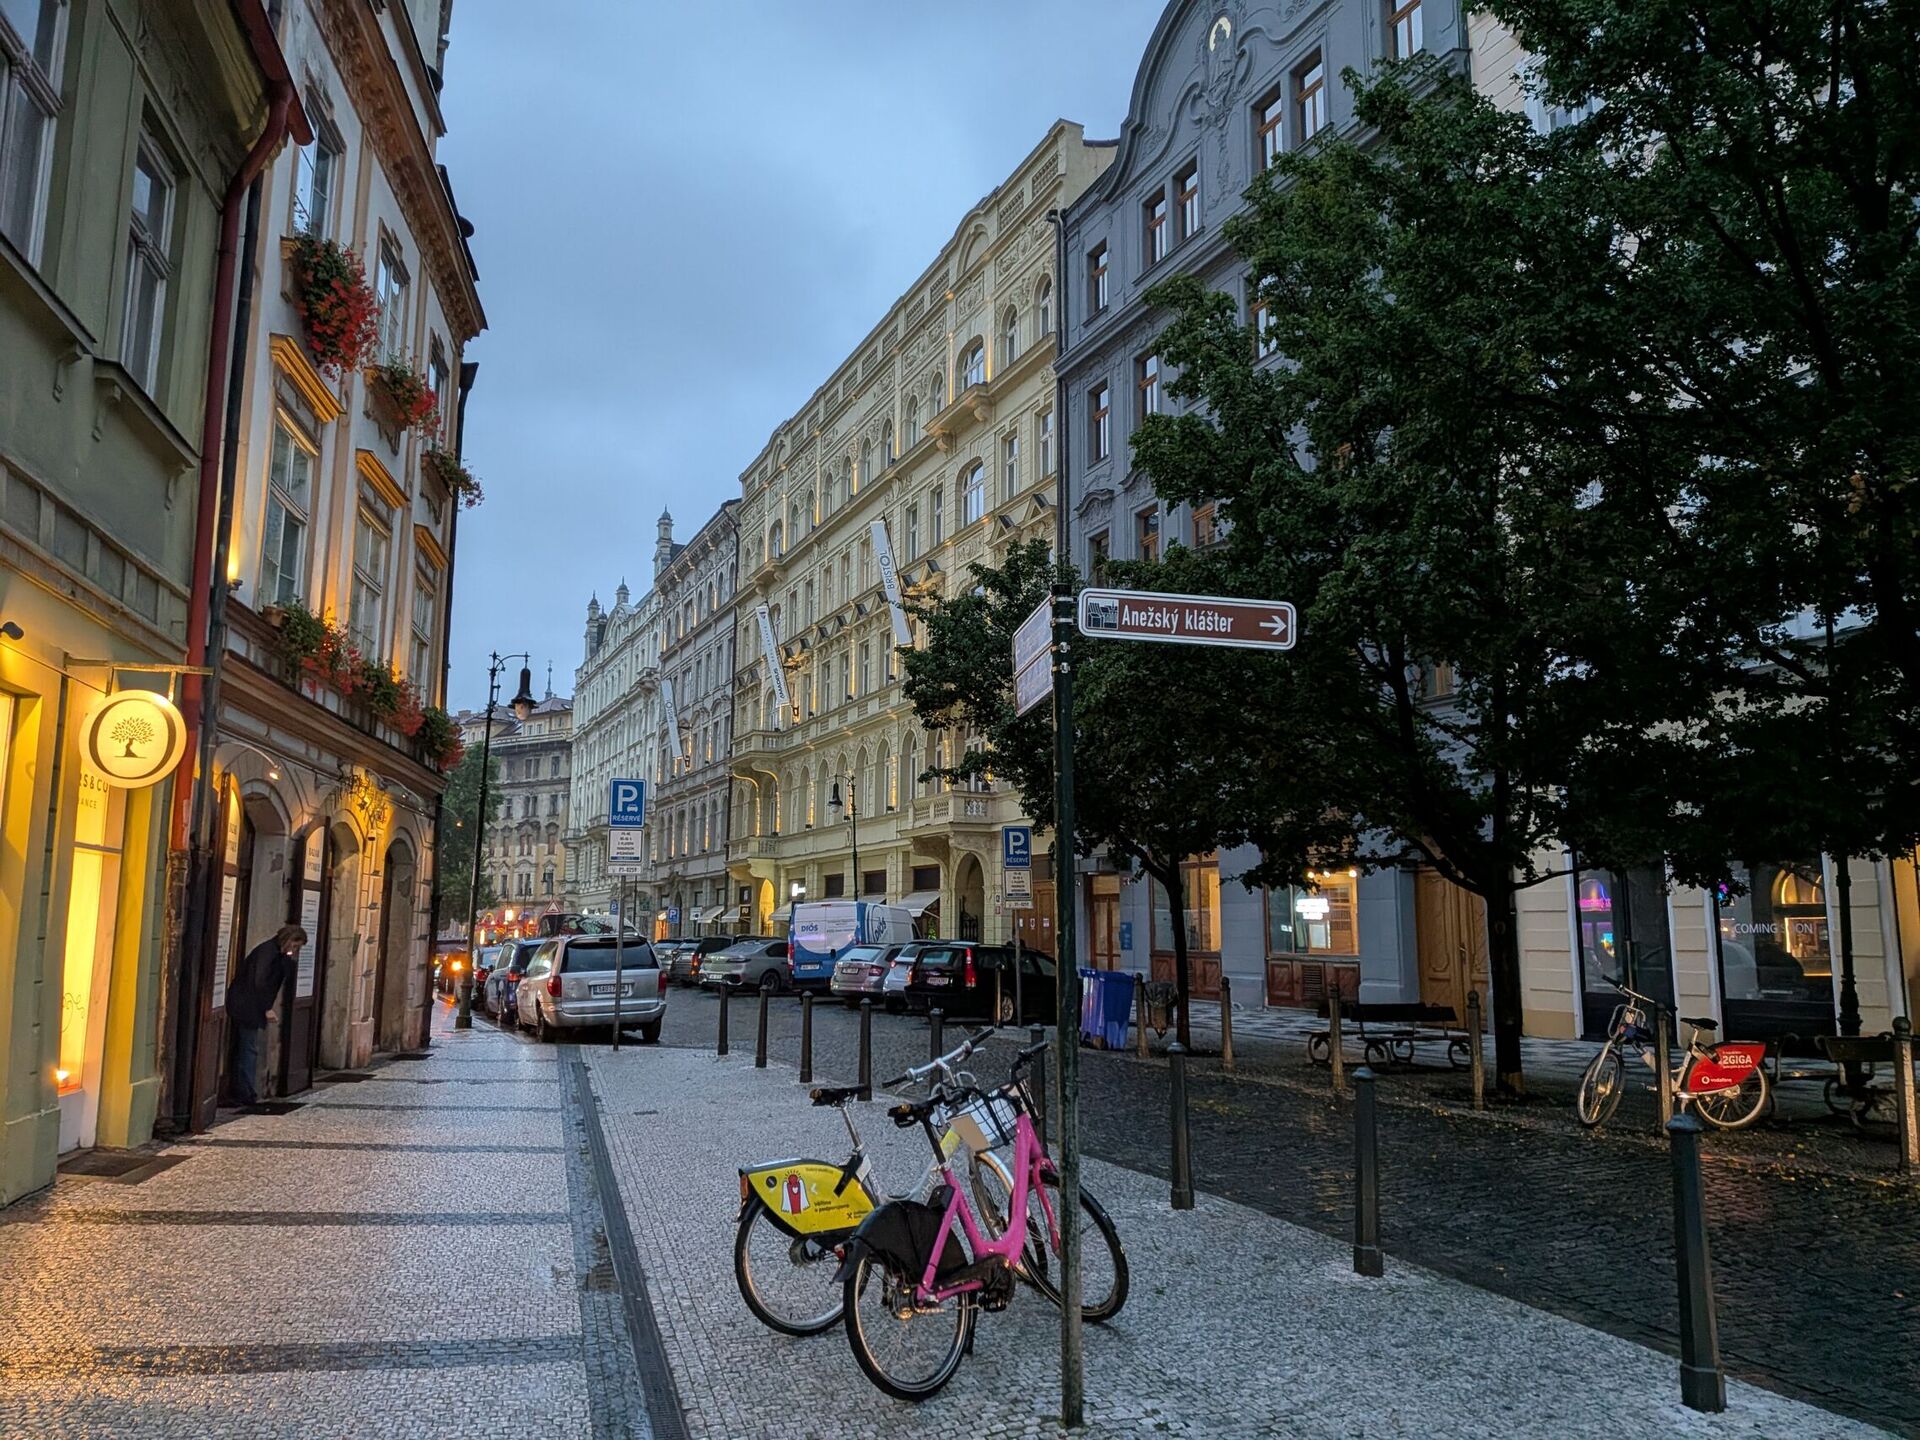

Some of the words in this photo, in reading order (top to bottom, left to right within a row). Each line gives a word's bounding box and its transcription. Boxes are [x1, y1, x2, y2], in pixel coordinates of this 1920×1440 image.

[880, 551, 895, 590] BRISTOL
[1121, 604, 1179, 634] Anežský
[1185, 608, 1234, 633] klášter
[617, 785, 638, 812] P
[1009, 832, 1025, 855] P
[801, 922, 819, 933] DIÓS
[1735, 923, 1778, 934] COMING
[1722, 1054, 1753, 1065] 2GIGA
